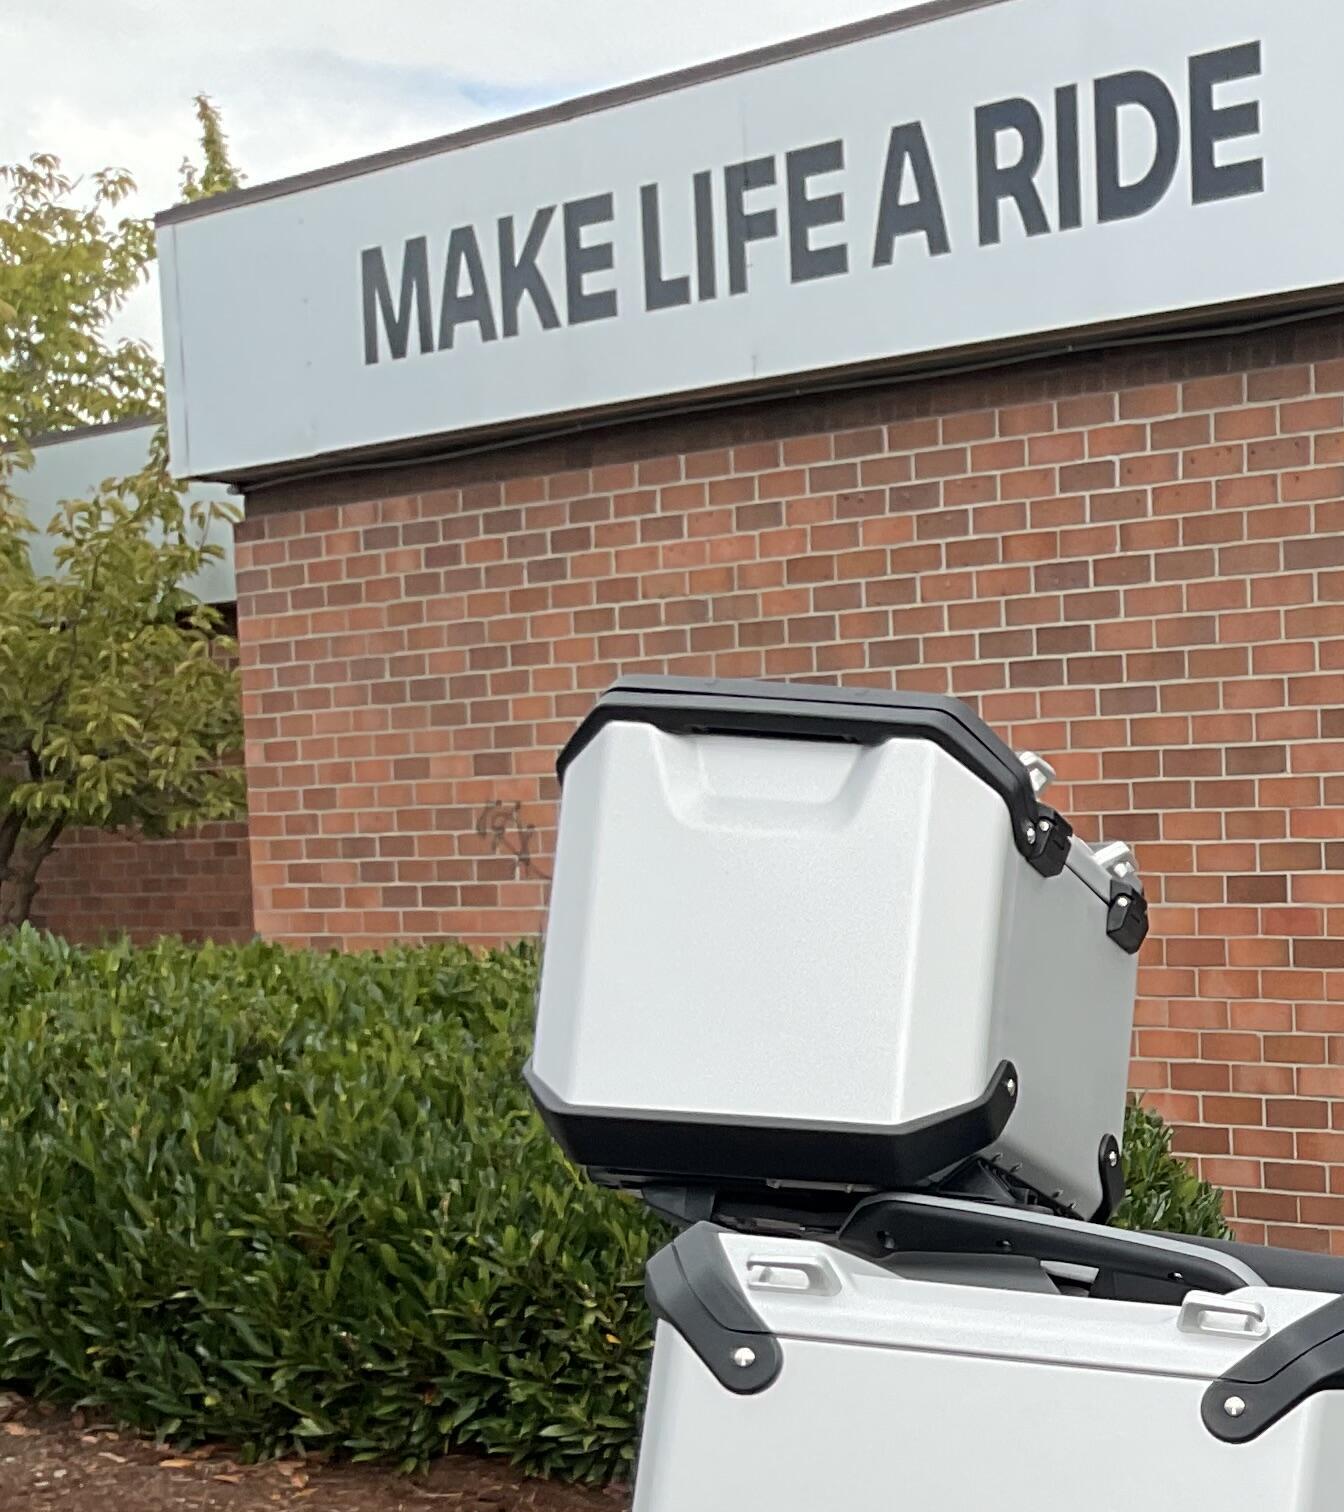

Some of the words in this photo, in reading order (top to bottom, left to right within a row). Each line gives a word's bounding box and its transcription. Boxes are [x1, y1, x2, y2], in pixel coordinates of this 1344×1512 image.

[361, 192, 618, 365] MAKE
[641, 138, 850, 312] LIFE
[873, 121, 950, 268] A
[974, 40, 1265, 247] RIDE
